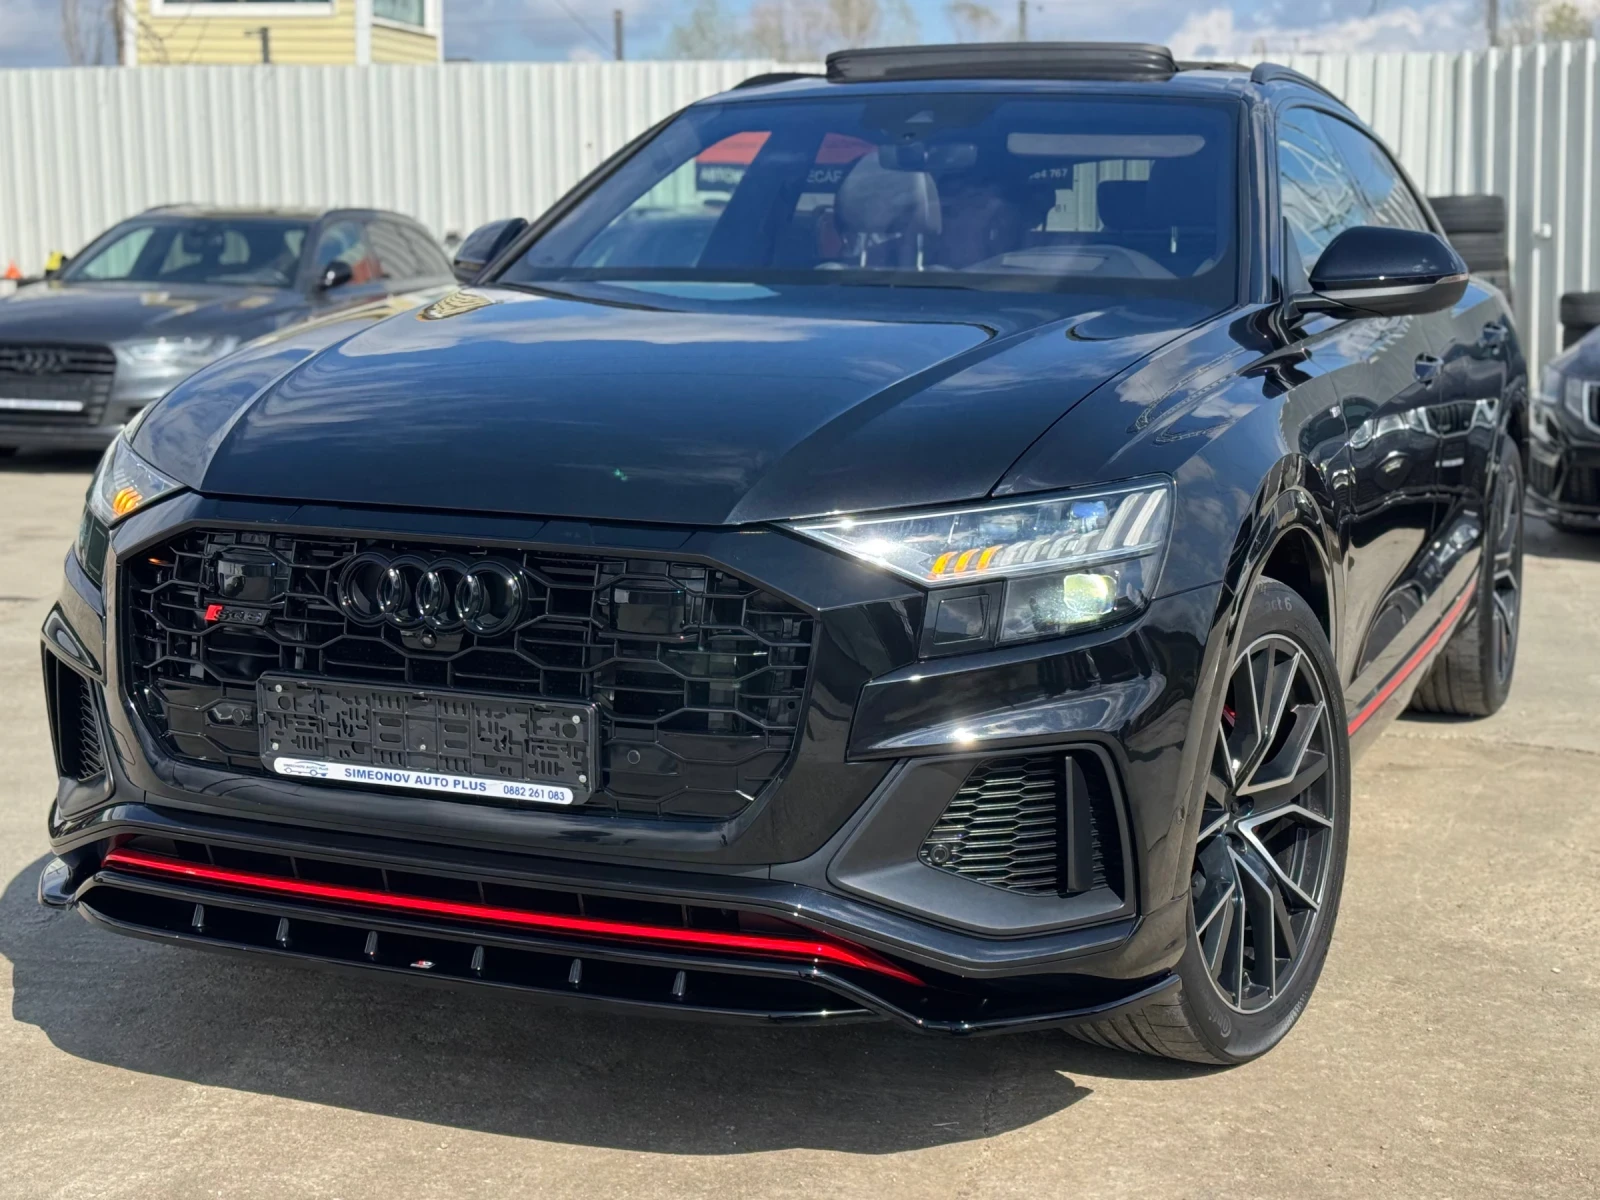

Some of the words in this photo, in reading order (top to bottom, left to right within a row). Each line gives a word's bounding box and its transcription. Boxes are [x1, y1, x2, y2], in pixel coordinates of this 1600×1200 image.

[344, 768, 411, 783] SIMEONOV
[414, 775, 449, 787] AUTO
[453, 779, 487, 792] PLUS
[503, 784, 526, 796] 0882
[528, 788, 544, 798] 261
[547, 790, 565, 800] 083
